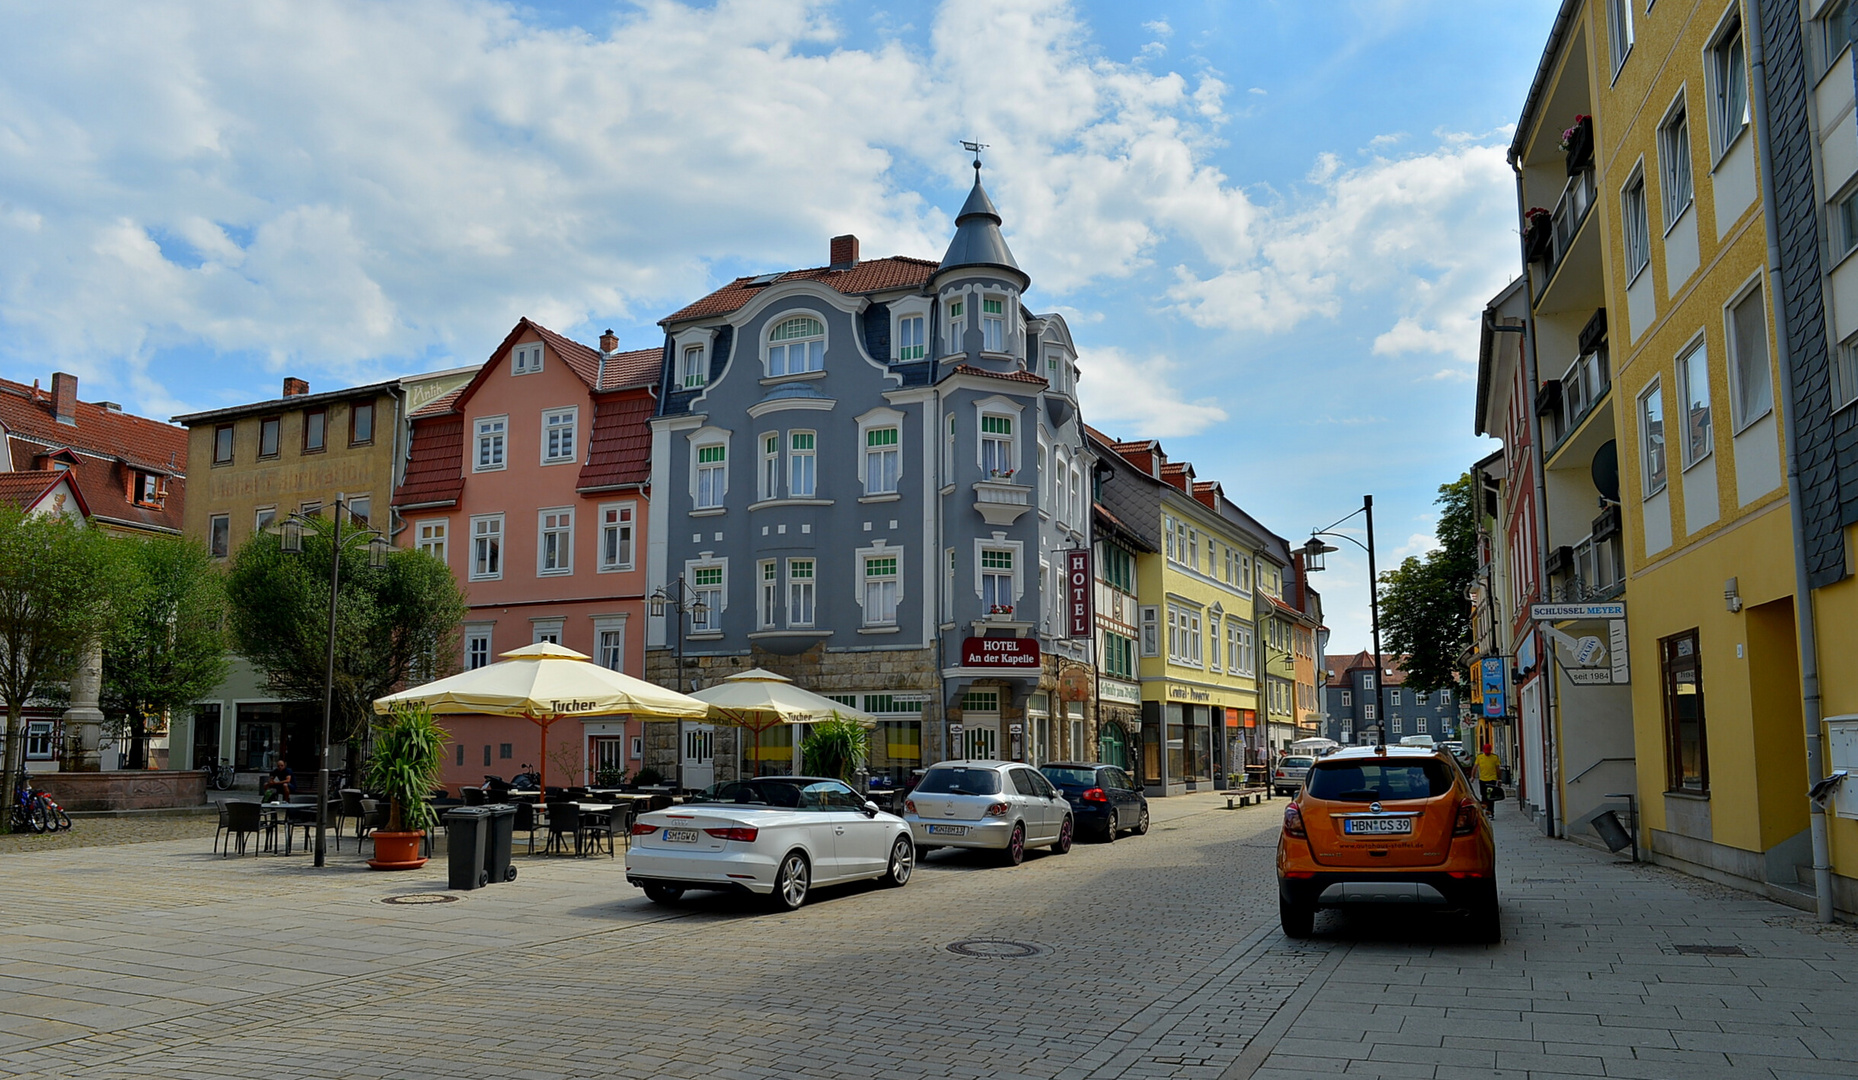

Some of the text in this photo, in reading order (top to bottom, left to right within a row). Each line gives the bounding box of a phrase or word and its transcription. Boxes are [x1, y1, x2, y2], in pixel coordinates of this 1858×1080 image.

[1072, 557, 1085, 631] HOTEL
[1534, 606, 1622, 616] SCHLÜSSEL MEYER
[983, 640, 1020, 651] HOTEL
[968, 653, 1034, 665] An der Kapelle
[1590, 672, 1609, 680] 1984
[550, 699, 597, 713] Tucher
[787, 712, 813, 721] Tucher
[1351, 819, 1410, 831] HBN CS 39
[668, 831, 696, 840] SM GW 6
